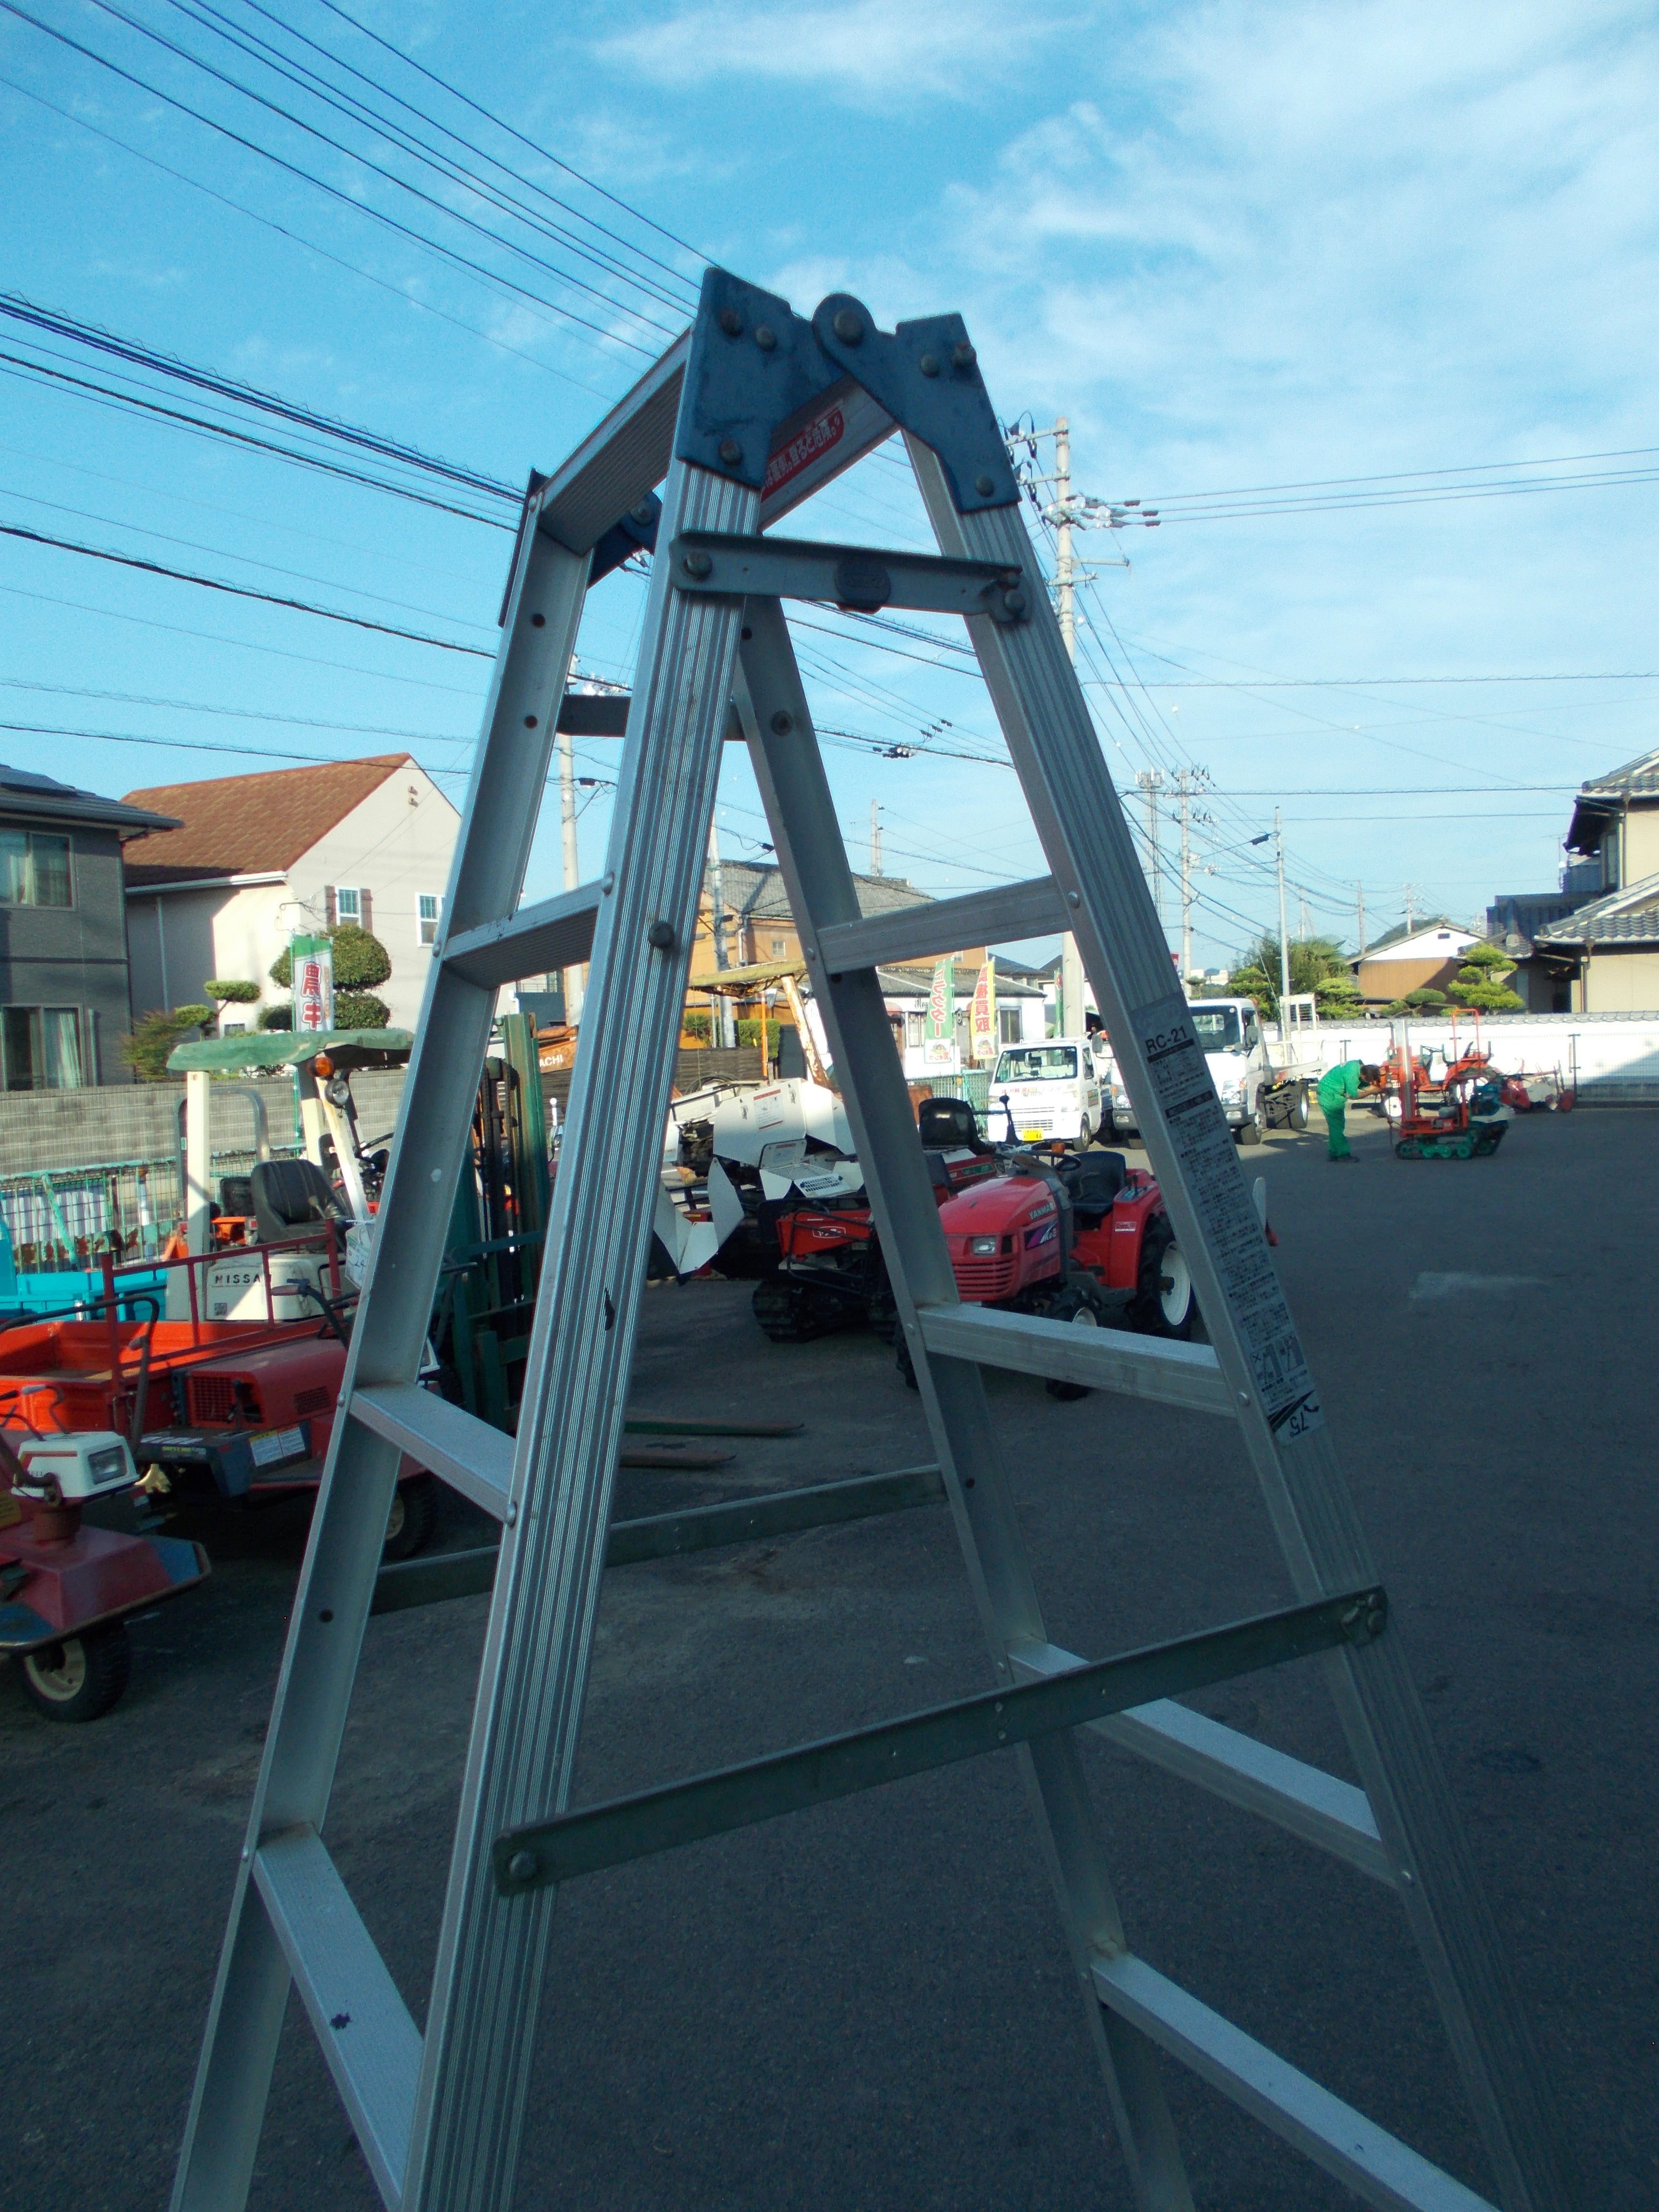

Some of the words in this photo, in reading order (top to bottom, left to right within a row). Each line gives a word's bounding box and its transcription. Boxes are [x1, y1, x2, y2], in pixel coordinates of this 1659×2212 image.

[301, 961, 322, 1031] 農キ
[1145, 1026, 1187, 1053] RC-21
[540, 1054, 563, 1067] ACHI
[1028, 1202, 1054, 1219] YANMAR
[215, 1274, 261, 1284] NISSA
